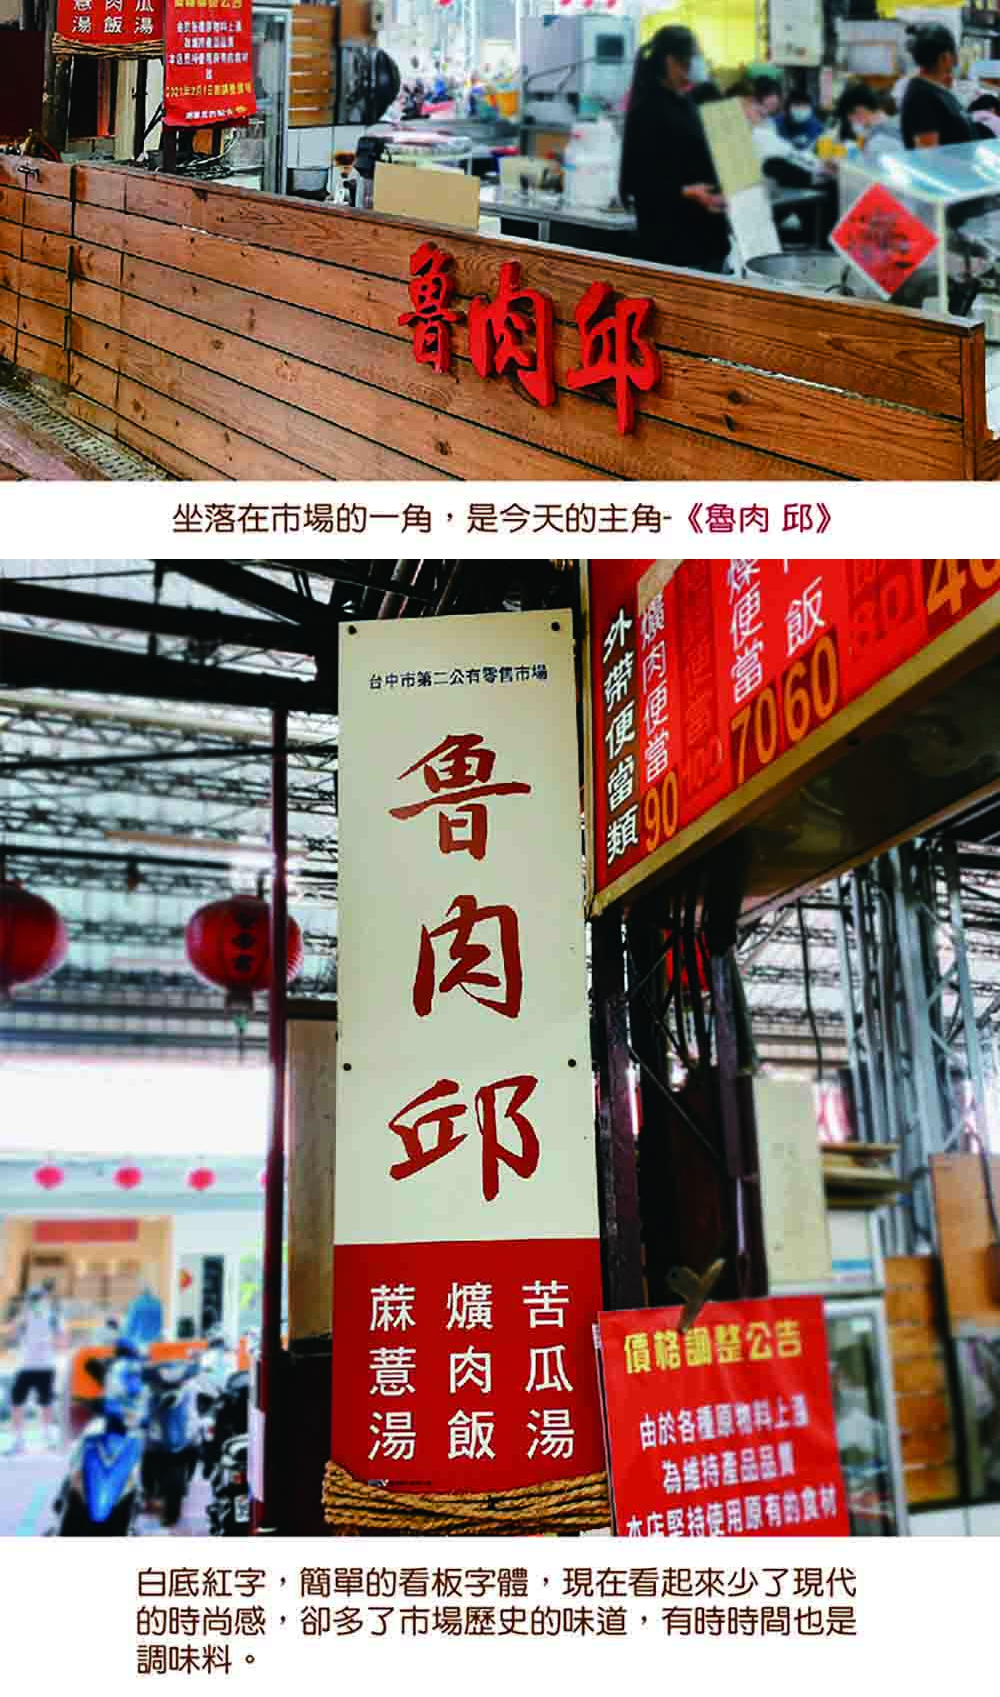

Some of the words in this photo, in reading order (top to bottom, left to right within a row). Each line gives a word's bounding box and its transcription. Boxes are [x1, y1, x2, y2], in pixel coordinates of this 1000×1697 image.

[398, 240, 663, 437] 魯肉邱
[368, 663, 549, 690] 台中市第二公有零售市場
[603, 607, 640, 865] 外帶便當類
[731, 685, 777, 785] 70
[784, 634, 839, 743] 60
[644, 770, 679, 852] 90
[388, 734, 540, 1201] 魯肉邱
[446, 1282, 496, 1460] 爌肉飯
[521, 1280, 576, 1460] 苦瓜湯
[624, 1319, 803, 1374] 價格調整公告
